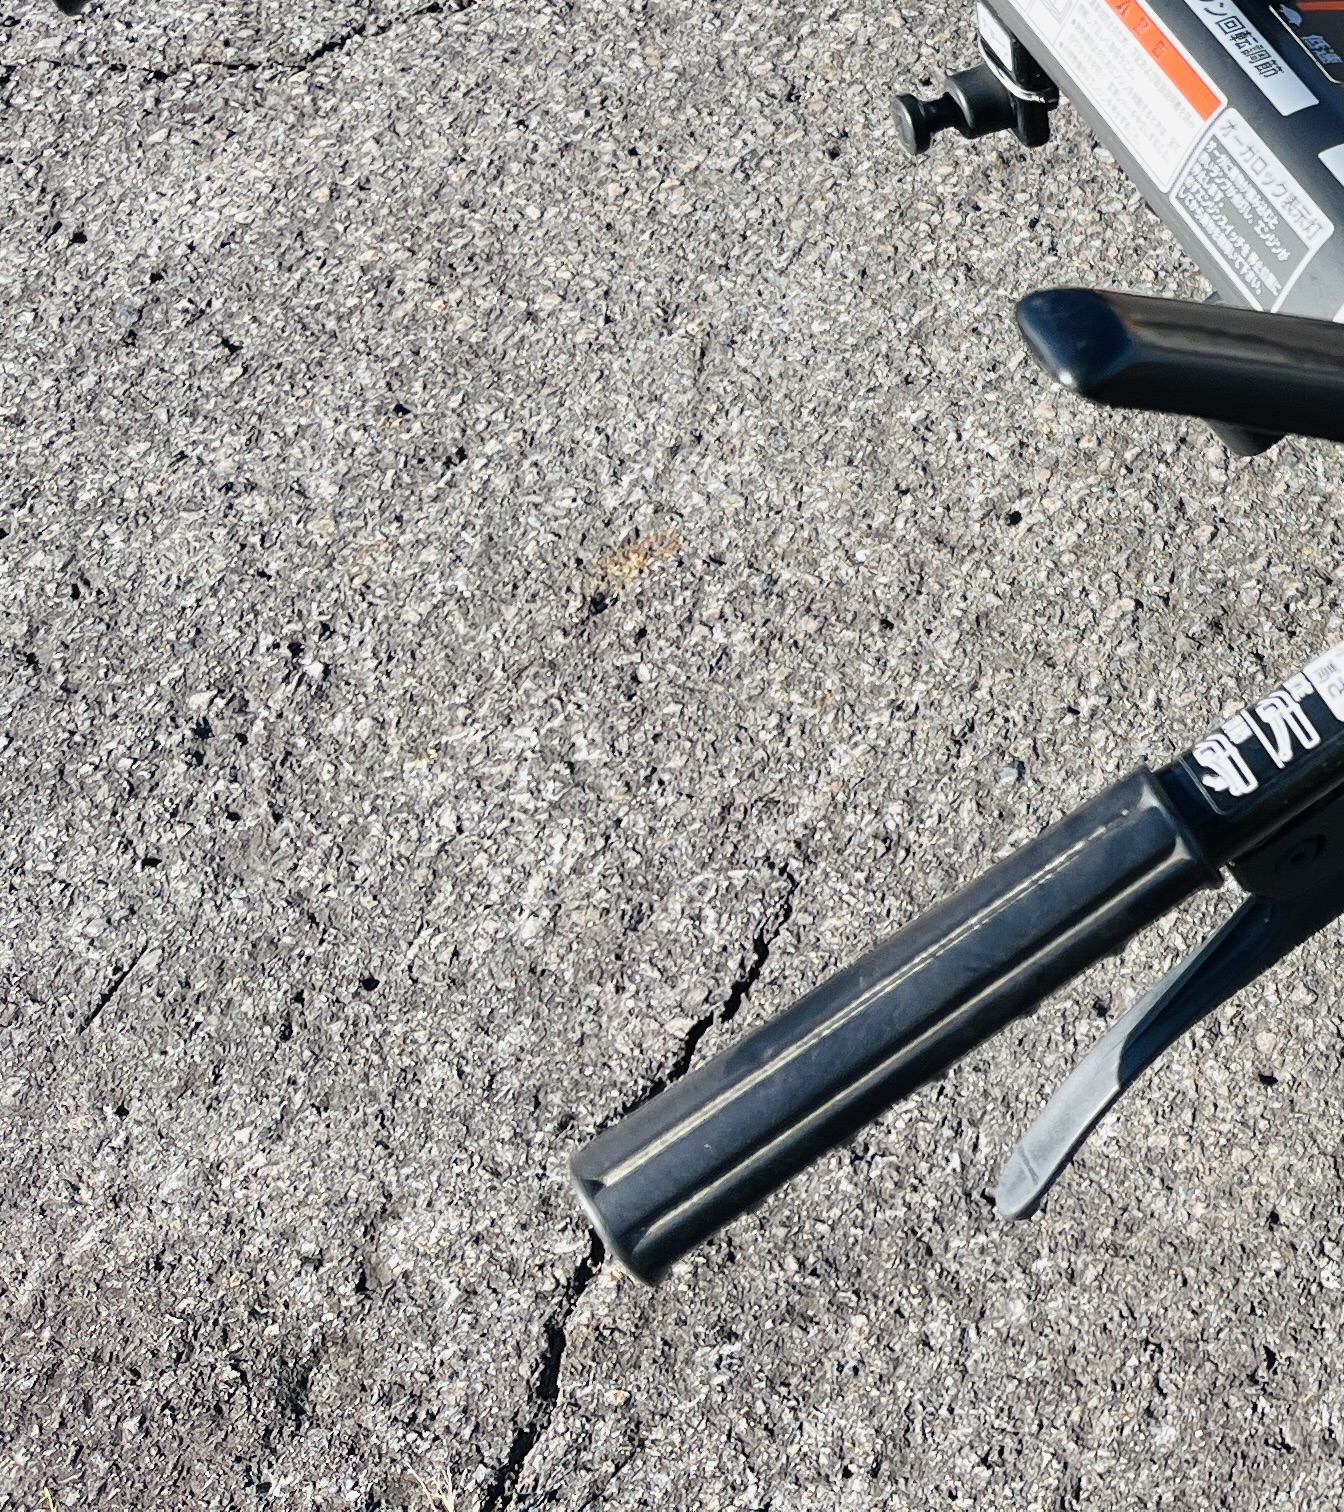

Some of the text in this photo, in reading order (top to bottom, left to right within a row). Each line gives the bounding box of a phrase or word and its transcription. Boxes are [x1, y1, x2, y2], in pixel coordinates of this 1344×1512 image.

[1221, 119, 1322, 240] オーガロック表示灯
